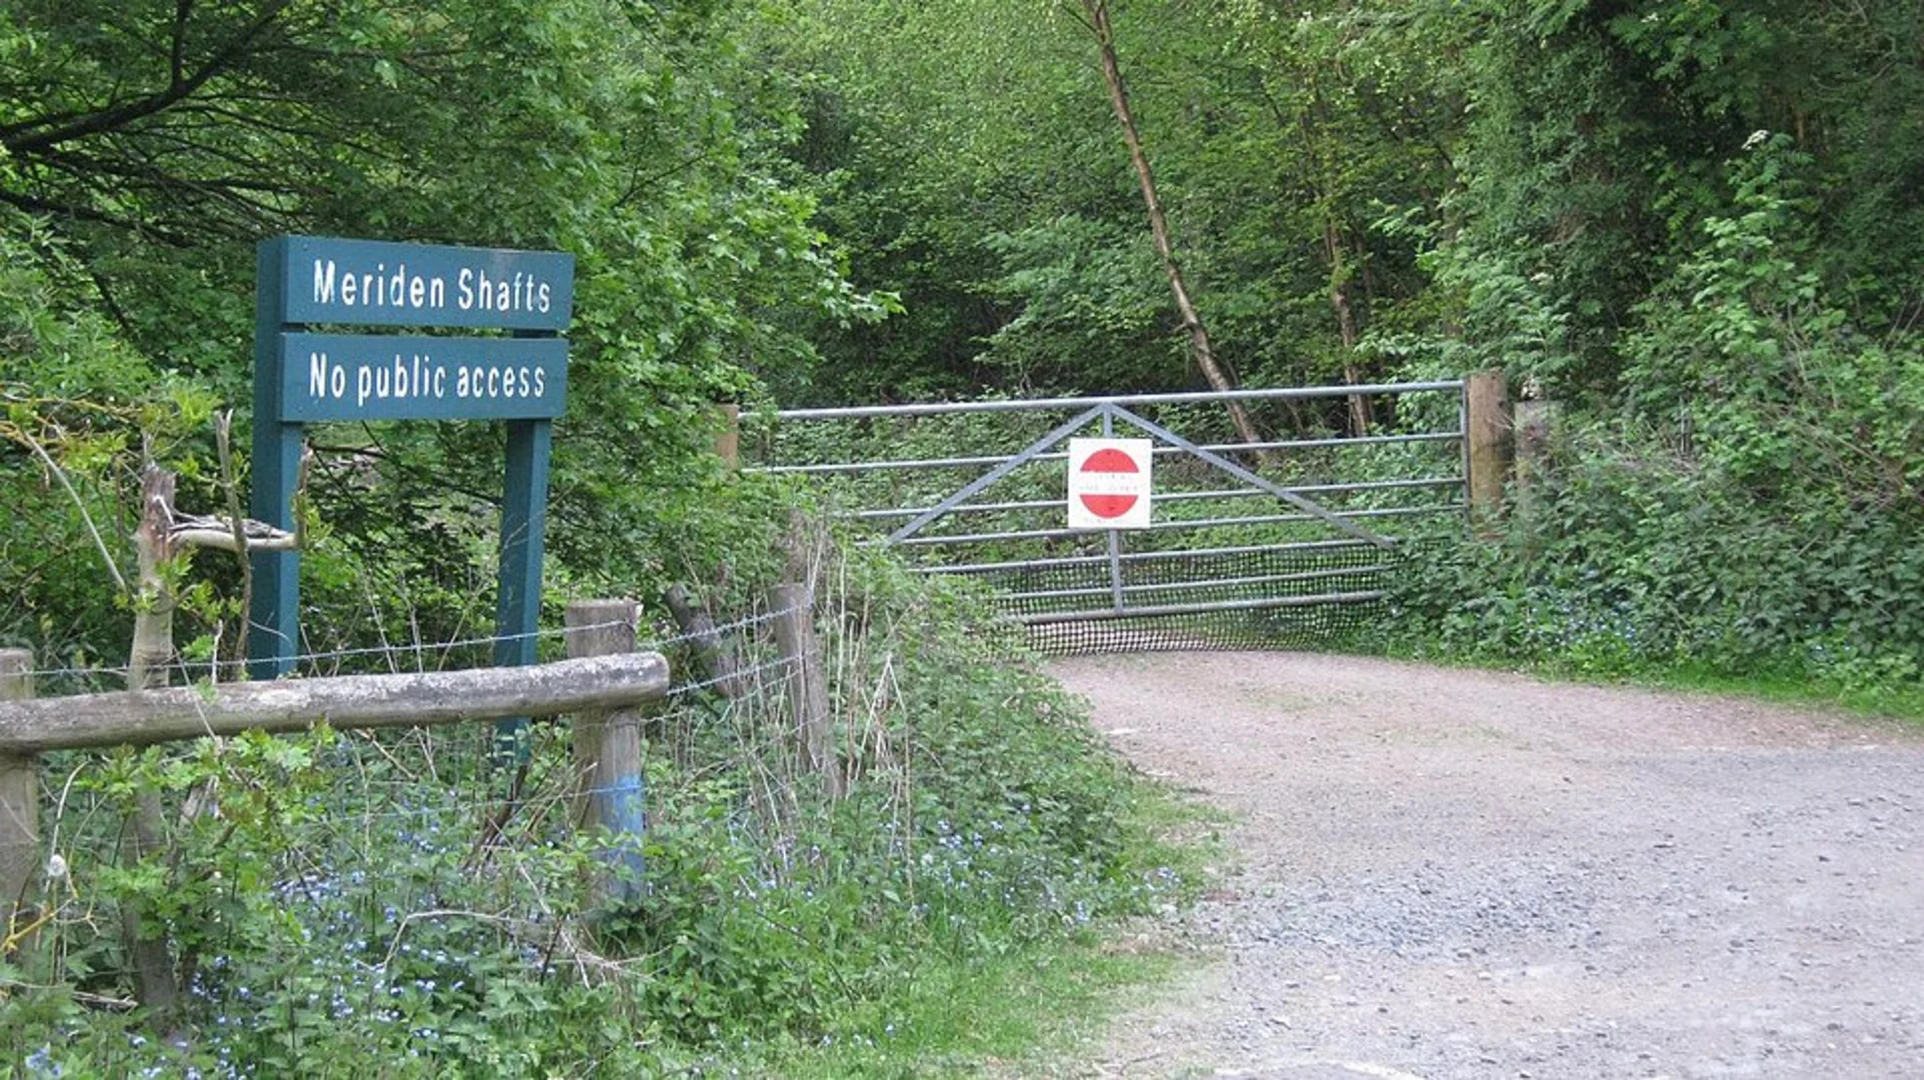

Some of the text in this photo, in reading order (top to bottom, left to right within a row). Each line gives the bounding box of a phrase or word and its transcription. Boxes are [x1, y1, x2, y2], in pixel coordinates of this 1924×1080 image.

[313, 260, 550, 314] Meriden Shafts
[309, 352, 546, 407] No public access
